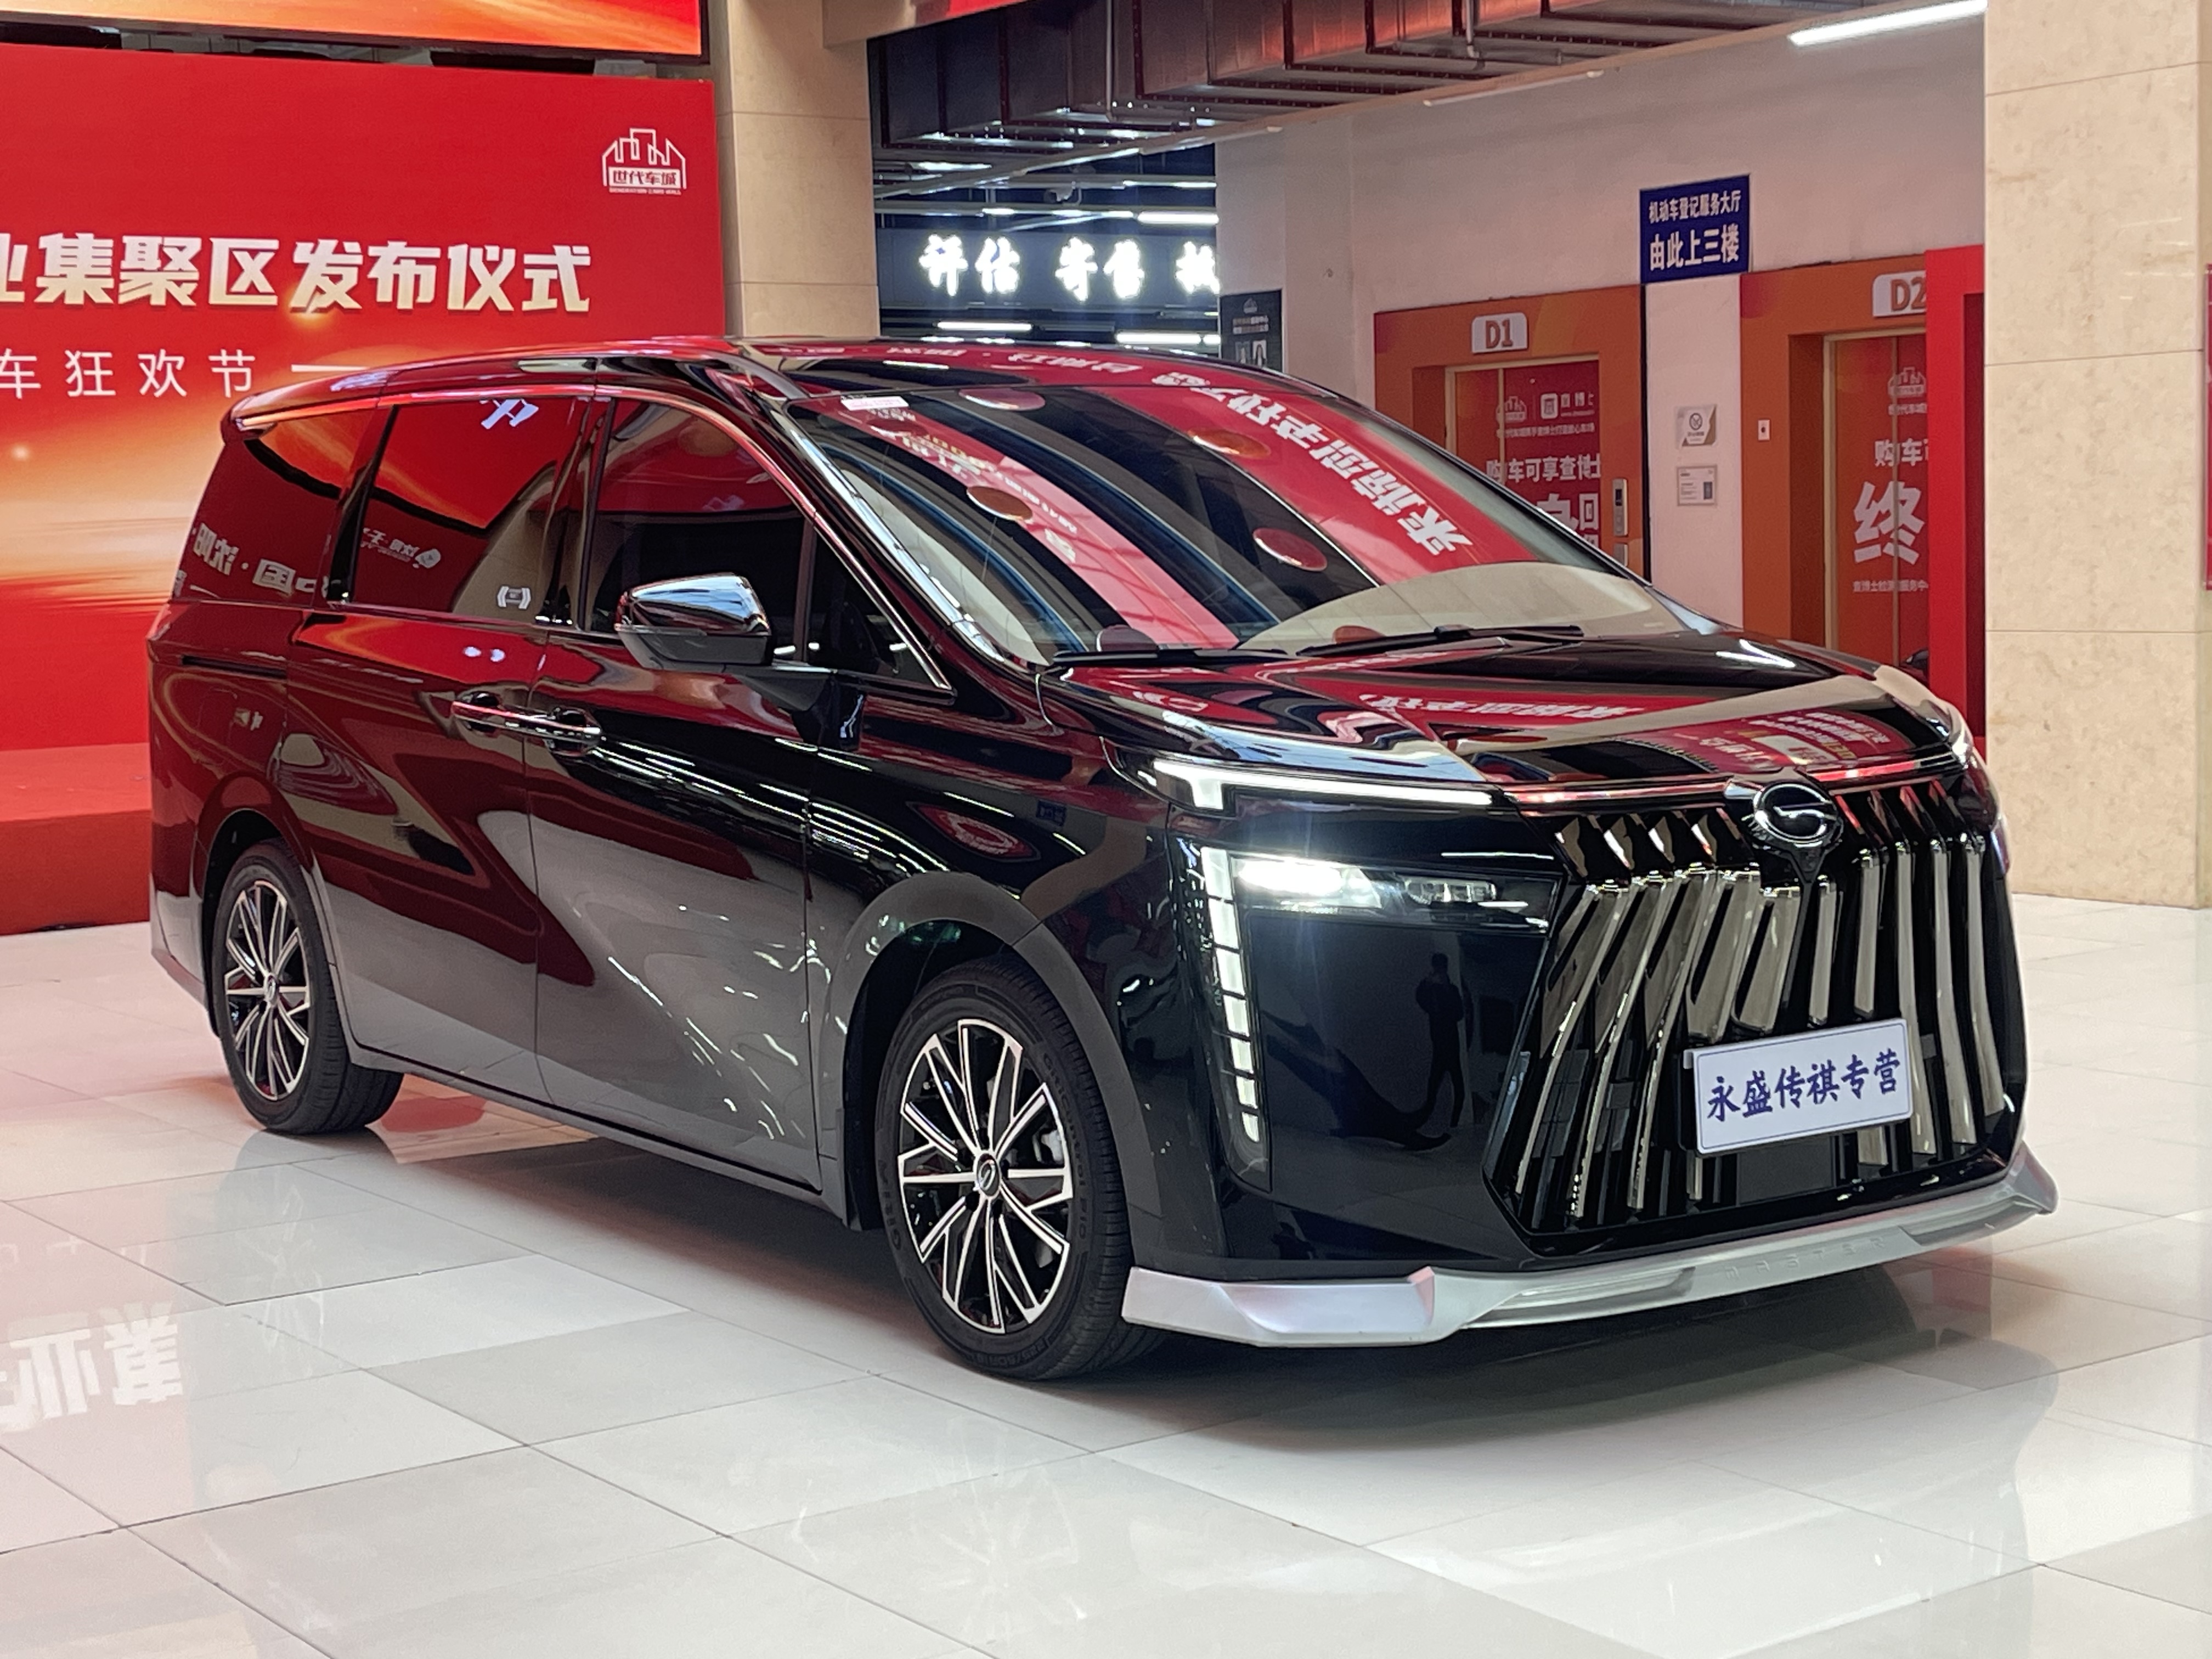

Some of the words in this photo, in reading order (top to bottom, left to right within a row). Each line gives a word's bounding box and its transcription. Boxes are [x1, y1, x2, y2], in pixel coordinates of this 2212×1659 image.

[612, 170, 677, 187] 世代车城
[1649, 190, 1741, 224] 机动车登记服务大厅
[1650, 222, 1739, 271] 由此上三楼
[1485, 319, 1514, 349] D1
[0, 348, 255, 399] 车狂欢节
[1875, 438, 1929, 466] 购车
[1853, 481, 1925, 565] 终
[1707, 1048, 1901, 1122] 永盛传祺专营
